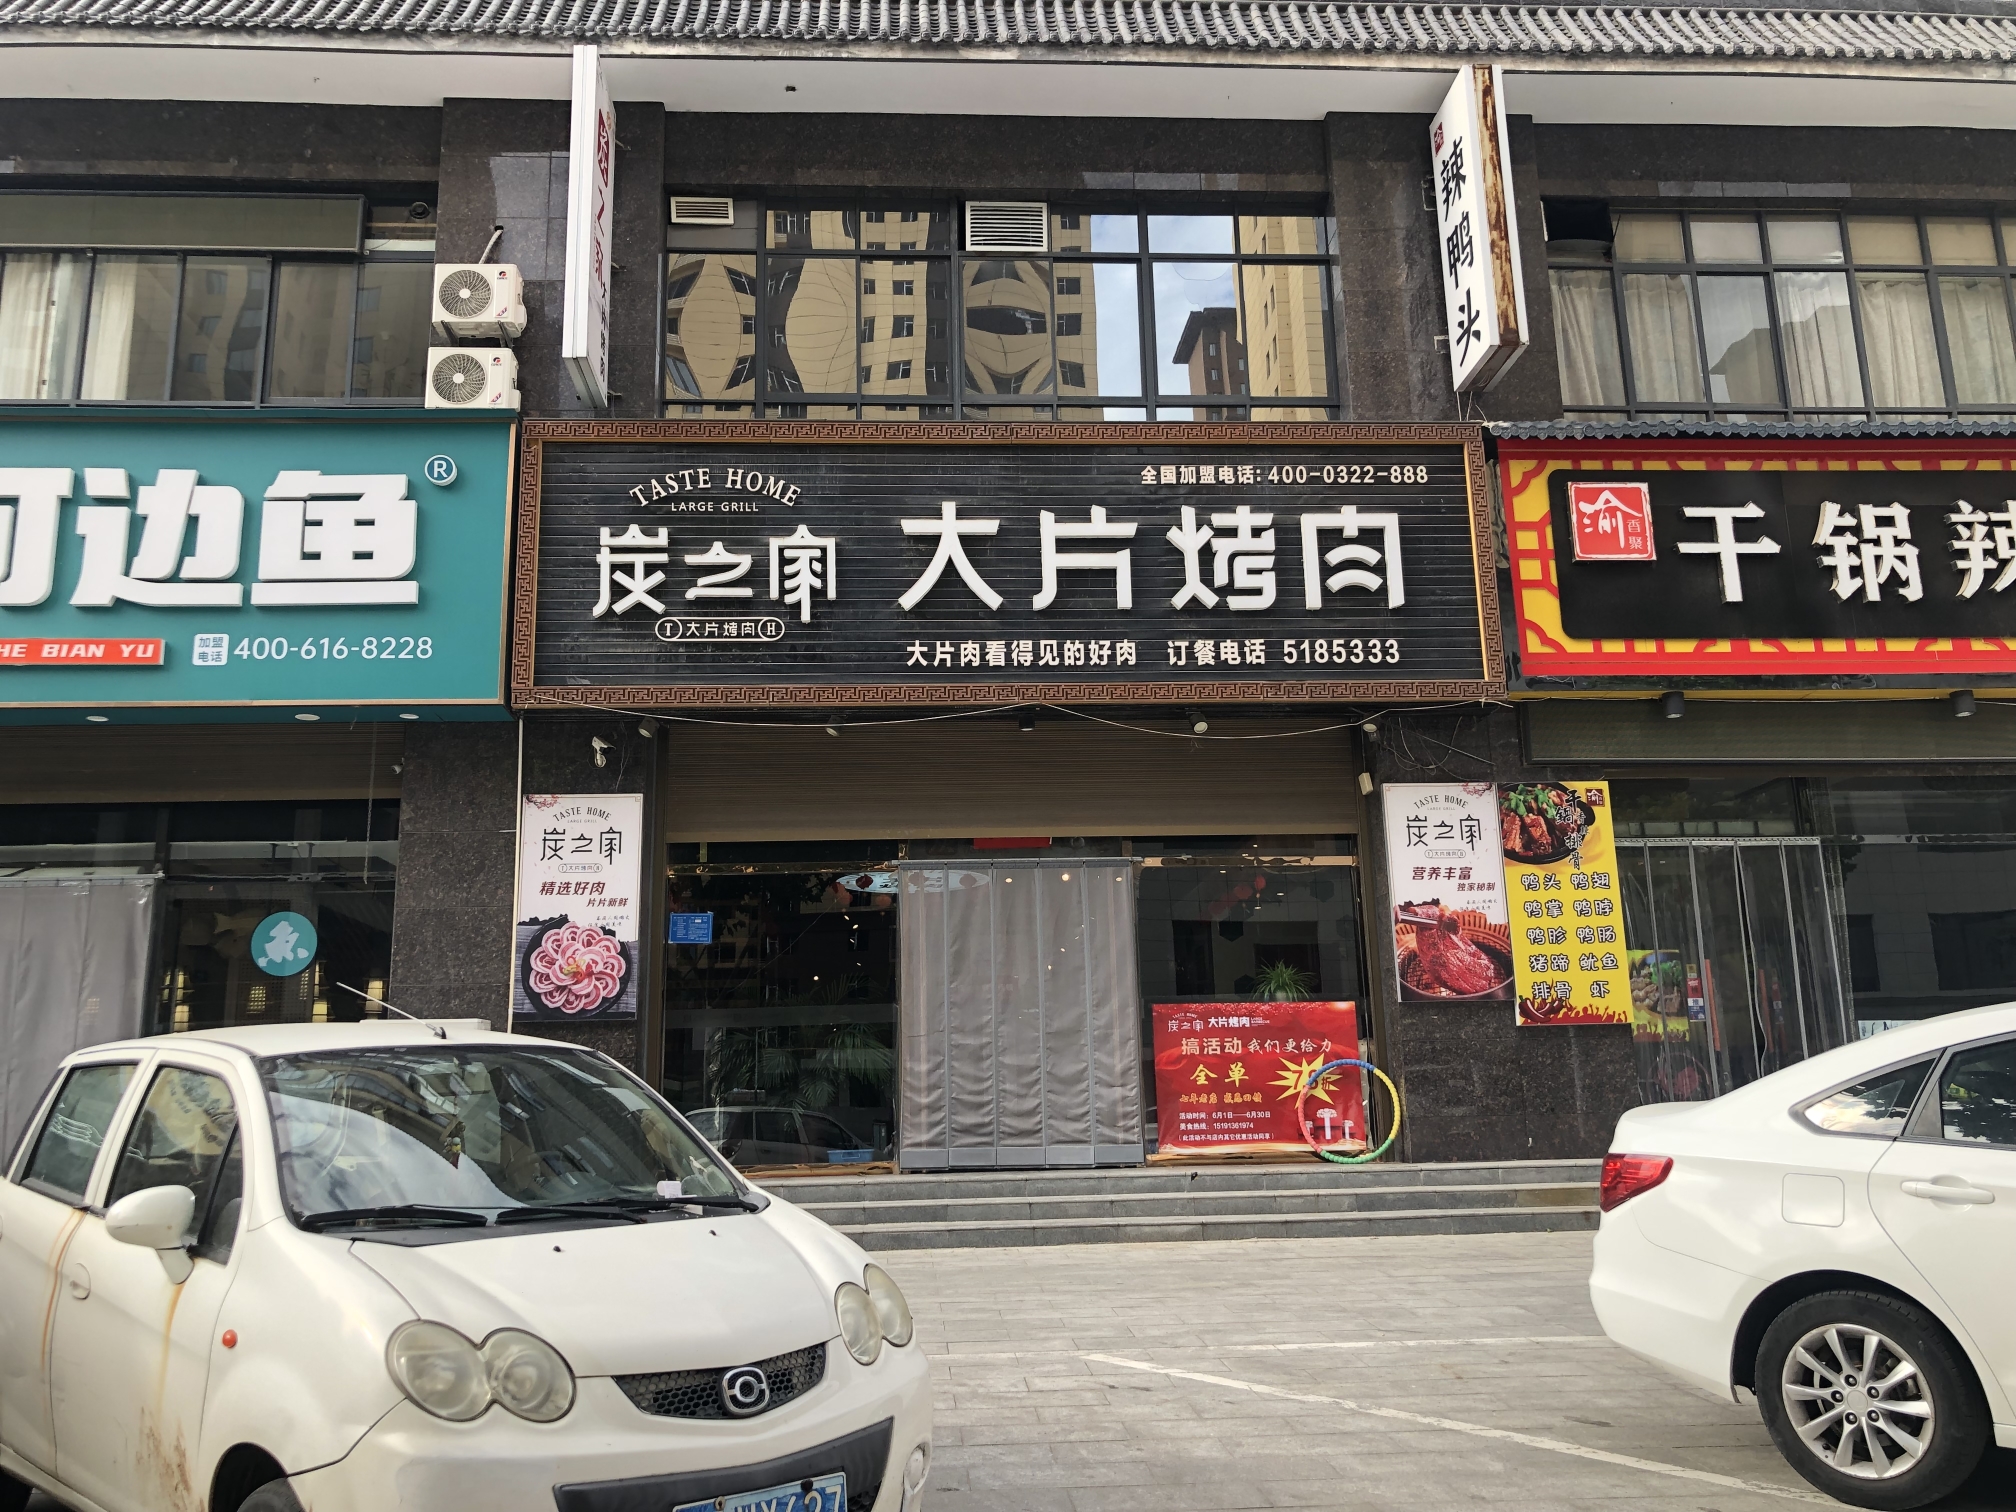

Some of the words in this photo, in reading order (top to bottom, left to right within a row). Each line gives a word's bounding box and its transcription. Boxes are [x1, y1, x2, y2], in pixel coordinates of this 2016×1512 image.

[1441, 136, 1482, 367] 辣鸭头
[1268, 465, 1428, 484] 400-0322-888
[629, 468, 711, 507] TASTE
[725, 468, 802, 507] HOME
[671, 502, 714, 512] LARGE
[721, 502, 759, 512] GRILL
[898, 501, 1405, 611] 大片烤肉
[592, 524, 836, 623] 炭之家
[686, 621, 756, 637] 大片烤肉
[41, 644, 105, 657] BIAN
[120, 644, 154, 657] YU
[199, 636, 223, 648] 加盟
[234, 637, 434, 660] 400-616-8228
[198, 651, 223, 662] 电话
[906, 639, 1137, 667] 大片肉看得见的好肉
[1168, 639, 1266, 666] 订餐电话
[1283, 639, 1400, 664] 5185333
[1414, 795, 1439, 809] TASTE
[1445, 795, 1468, 808] HOME
[553, 807, 581, 821] TASTE
[587, 807, 611, 821] HOME
[1406, 814, 1481, 851] 炭之家
[540, 827, 622, 865] 炭之家
[1412, 867, 1472, 880] 营养丰富
[1521, 873, 1561, 890] 鸭头
[1571, 872, 1610, 889] 鸭翅
[539, 881, 605, 895] 精选好肉
[1457, 882, 1495, 891] 独家秘制
[587, 897, 628, 907] 片片新鲜
[1524, 899, 1563, 917] 鸭掌
[1573, 898, 1613, 916] 鸭脖
[1527, 926, 1567, 944] 鸭胗
[1576, 926, 1616, 943] 鸭肠
[1529, 953, 1569, 972] 猪蹄
[1579, 952, 1618, 971] 鱿鱼
[1532, 981, 1572, 999] 排骨
[1590, 981, 1610, 998] 虾
[1208, 1017, 1250, 1028] 大片烤肉
[1182, 1037, 1242, 1055] 搞活动
[1247, 1038, 1332, 1054] 我们更给力
[1190, 1062, 1249, 1087] 全单
